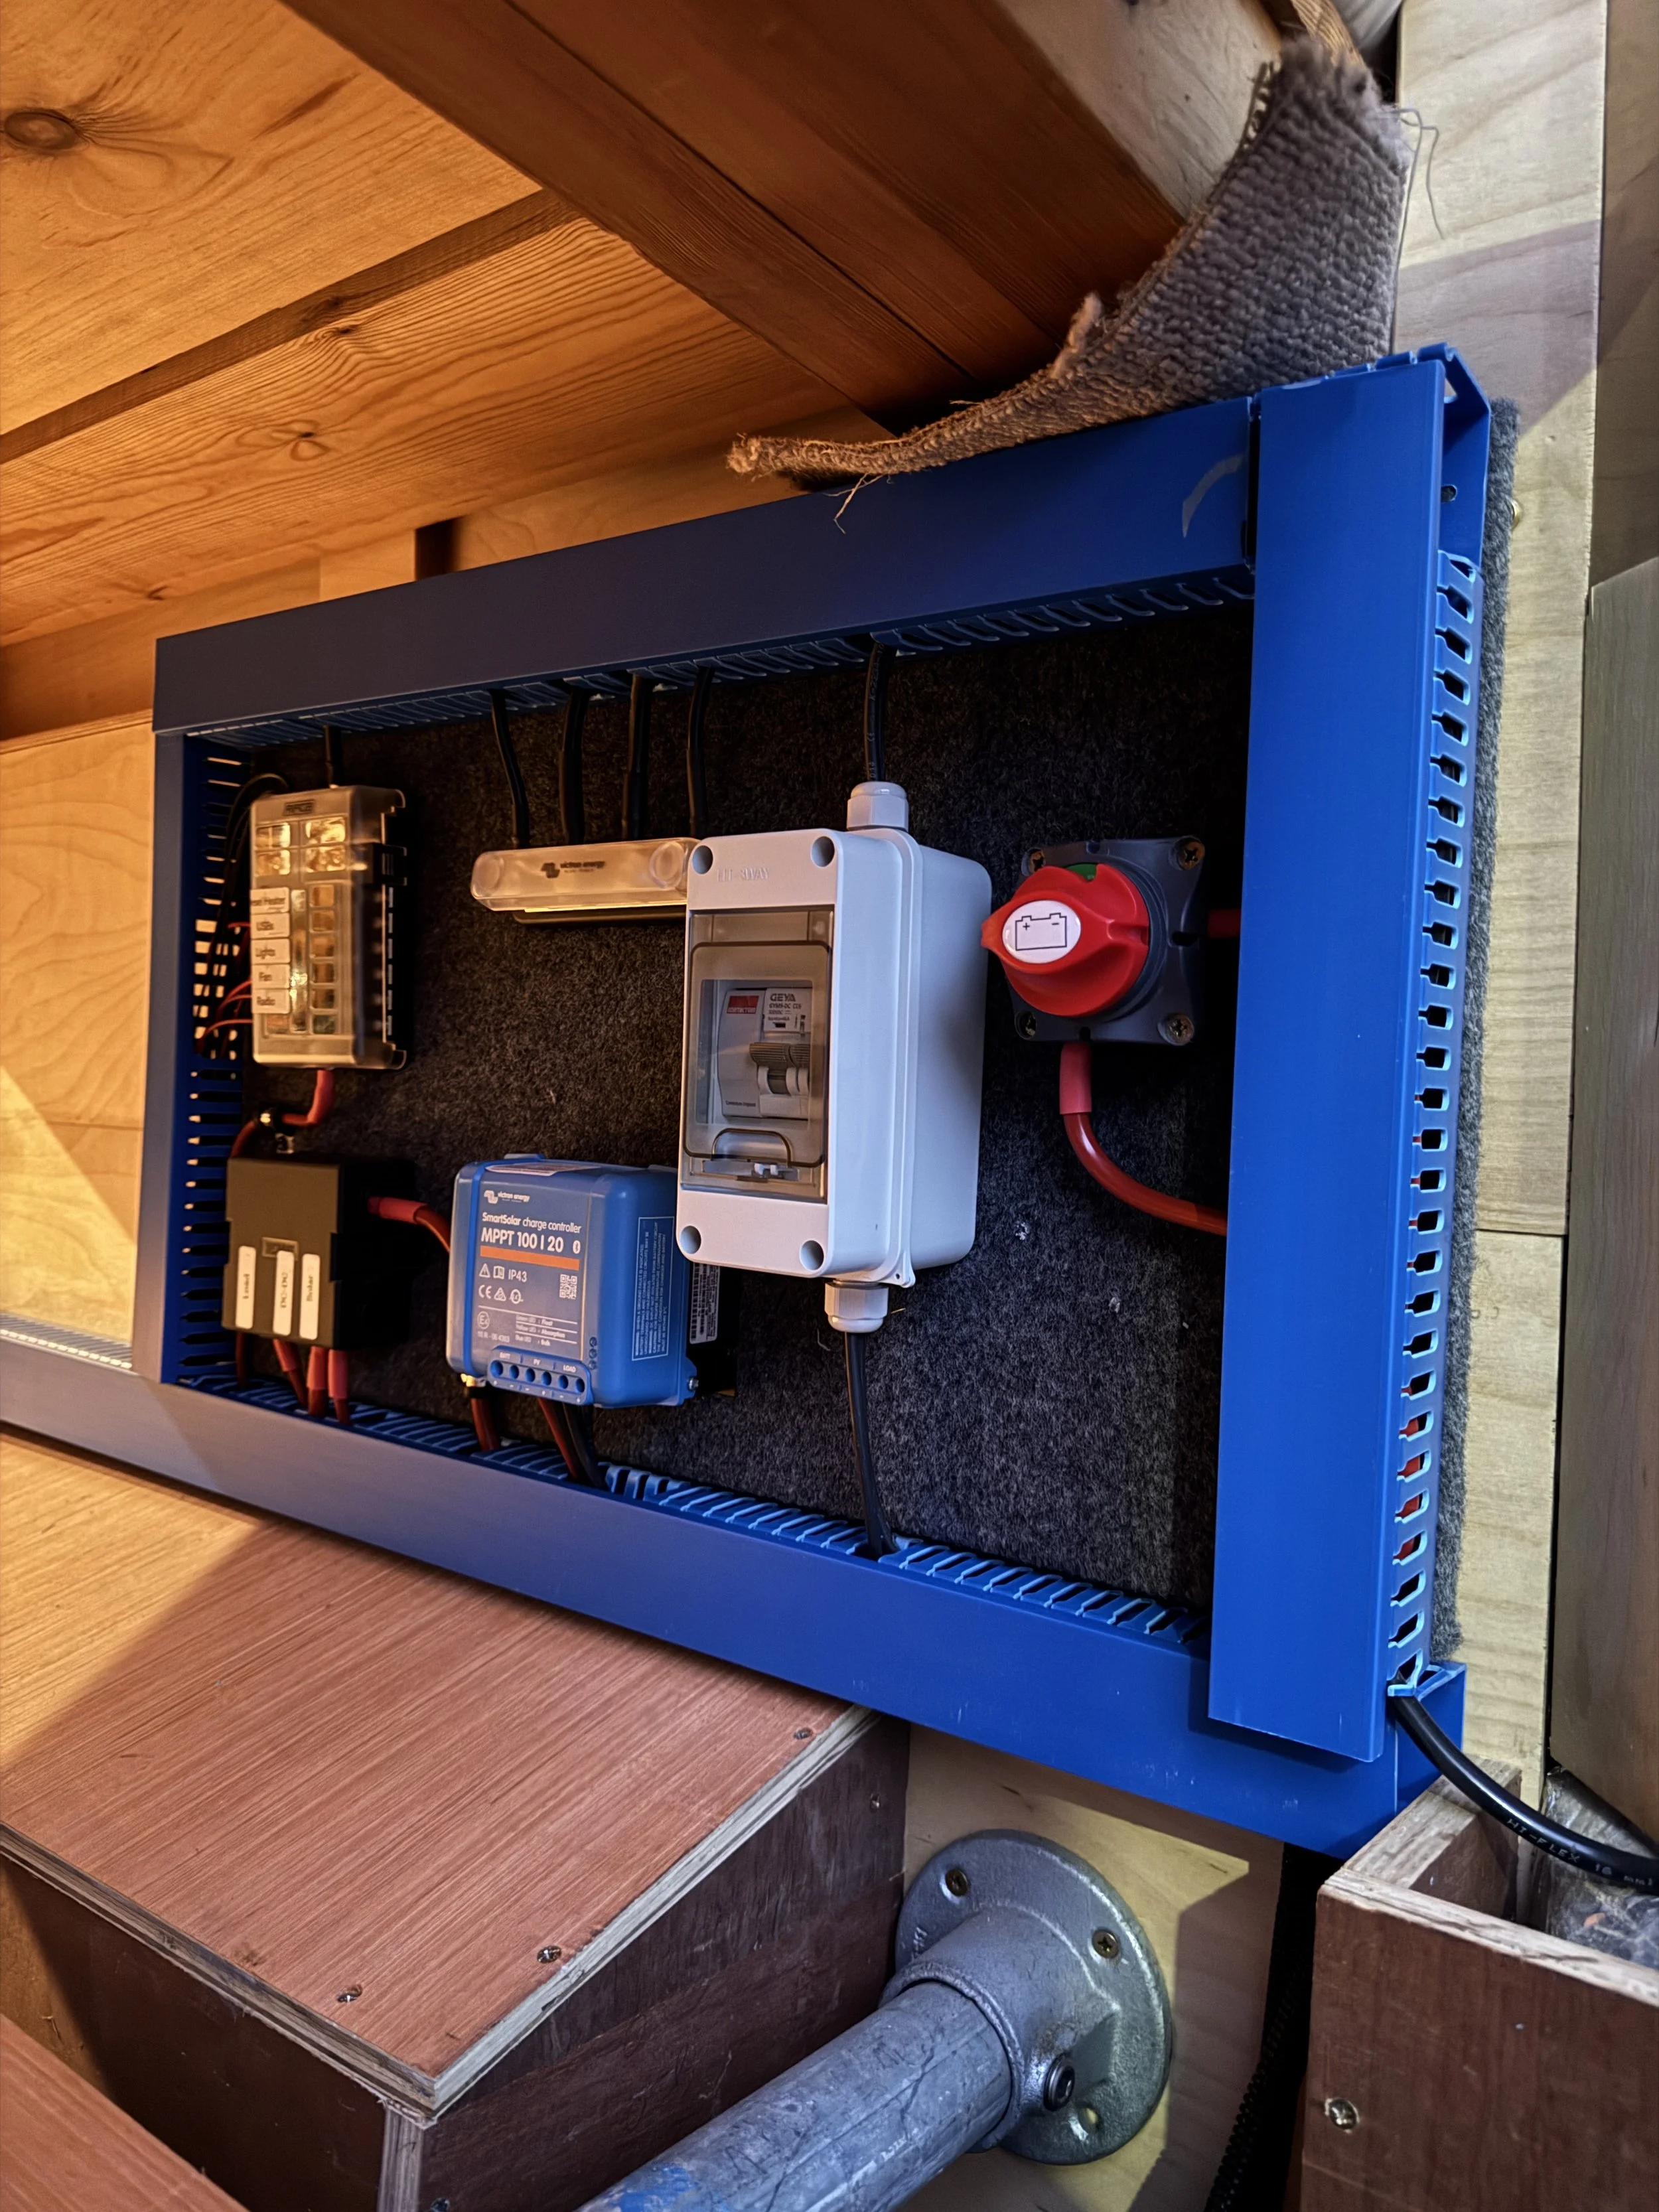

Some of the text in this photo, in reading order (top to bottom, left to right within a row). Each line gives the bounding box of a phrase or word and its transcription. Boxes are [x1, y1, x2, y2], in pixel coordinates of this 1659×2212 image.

[259, 972, 272, 982] Fan
[257, 996, 275, 1006] Radio
[770, 993, 796, 1001] GEYA
[514, 1194, 530, 1203] energy
[482, 1212, 582, 1233] SmartSolar charge controller
[481, 1227, 514, 1246] MPPT
[517, 1232, 538, 1249] 100
[547, 1236, 564, 1252] 20
[508, 1269, 528, 1282] IP43
[1506, 1818, 1580, 1863] HI-FLEX
